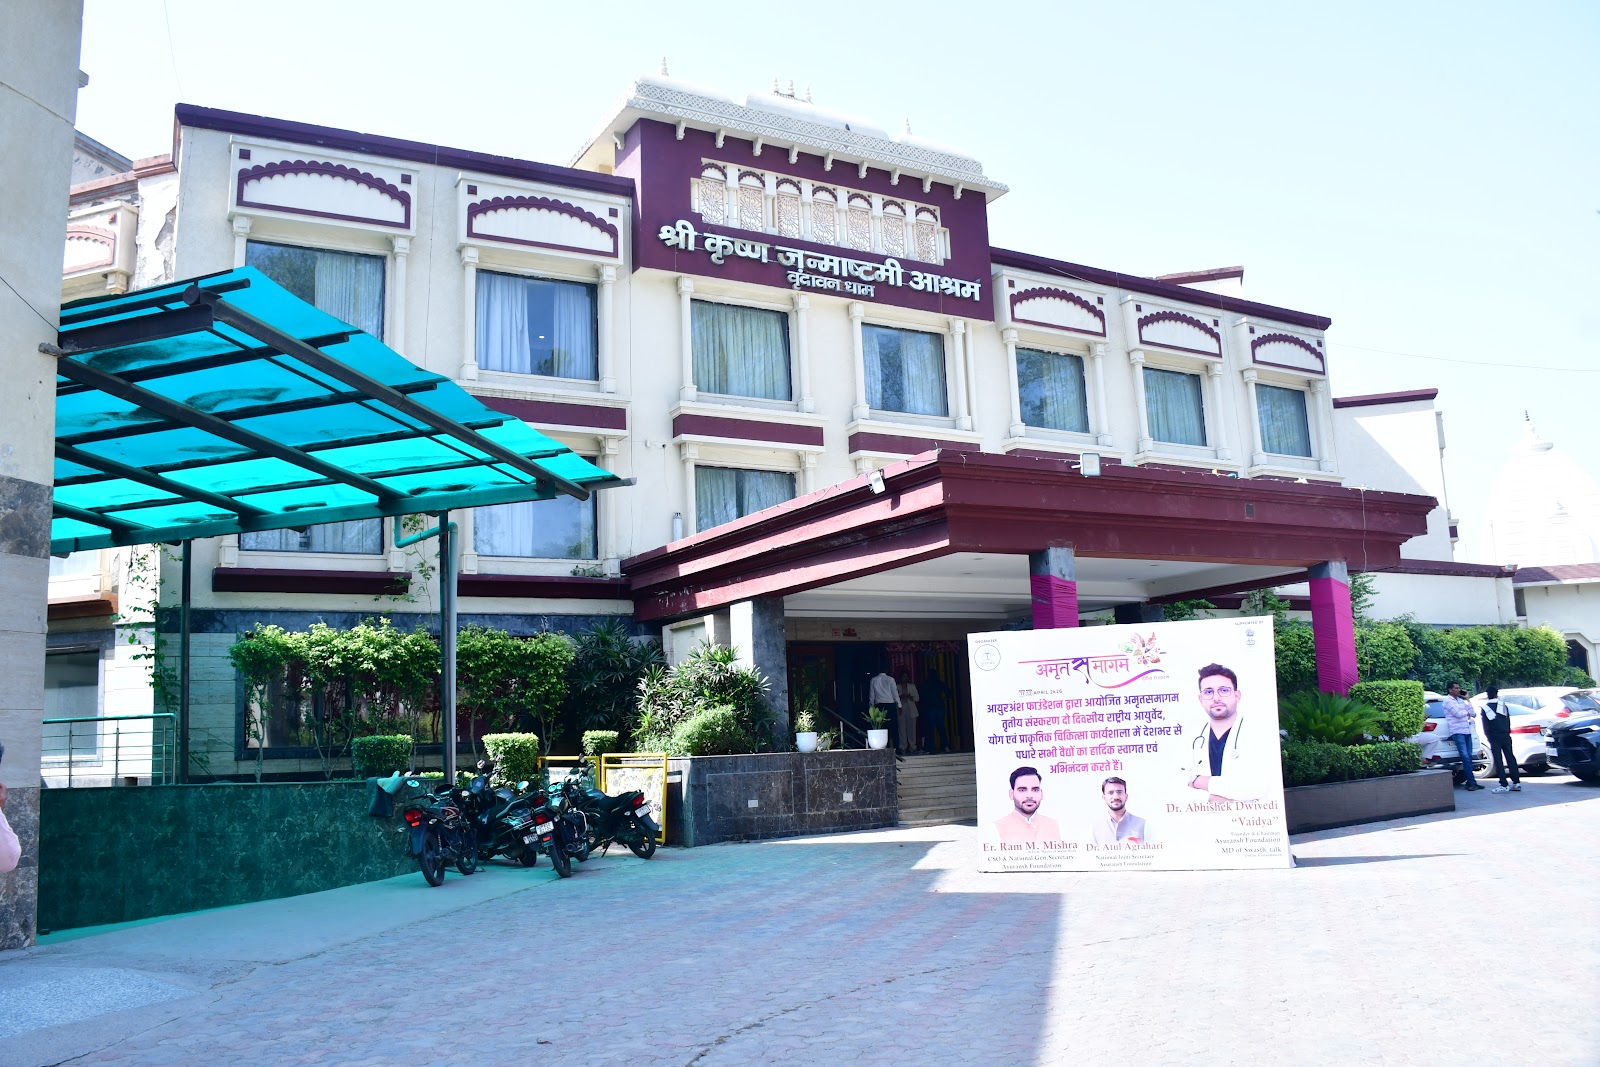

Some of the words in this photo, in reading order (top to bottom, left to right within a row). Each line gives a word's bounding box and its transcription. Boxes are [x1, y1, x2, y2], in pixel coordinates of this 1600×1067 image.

[657, 219, 698, 251] श्री
[703, 232, 770, 264] कृष्ण
[774, 245, 904, 286] जन्माष्टमी
[909, 270, 981, 301] आश्रम
[786, 269, 841, 290] वृंदावन
[845, 280, 875, 297] धाम
[1036, 662, 1071, 680] अमृत
[987, 701, 1024, 715] आयुरअंश
[1026, 699, 1064, 710] फाउंडेशन
[1065, 699, 1083, 710] द्वारा
[1085, 694, 1121, 707] आयोजित
[1124, 693, 1179, 708] अमृतसमागम
[1001, 716, 1023, 732] तृतीय
[1024, 716, 1060, 727] संस्करण
[1061, 713, 1071, 725] दो
[1072, 712, 1104, 724] दिवसीय
[1106, 710, 1131, 723] राष्ट्रीय
[1134, 708, 1165, 723] आयुर्वेद,
[988, 734, 1004, 745] योग
[1005, 733, 1017, 744] एवं
[1019, 731, 1052, 746] प्राकृतिक
[1054, 729, 1088, 741] चिकित्सा
[1090, 727, 1130, 739] कार्यशाला
[1132, 725, 1141, 737] में
[1143, 725, 1172, 737] देशभर
[1173, 723, 1183, 735] से
[1015, 747, 1036, 759] पधारे
[1038, 746, 1057, 758] सभी
[1059, 745, 1075, 757] वैद्यों
[1076, 747, 1088, 756] का
[1089, 742, 1115, 756] हार्दिक
[1117, 744, 1144, 754] स्वागत
[1146, 741, 1158, 753] एवं
[1050, 761, 1089, 773] अभिनंदन
[1090, 759, 1111, 771] करते
[1166, 803, 1182, 813] Dr.
[1185, 801, 1232, 812] Abhishek
[1235, 800, 1278, 811] Dwivedi
[983, 843, 997, 851] Er.
[1000, 842, 1023, 851] Ram
[1025, 841, 1040, 850] M.
[1043, 840, 1078, 850] Mishra
[1086, 843, 1100, 851] Dr.
[1124, 842, 1164, 852] Agrahari
